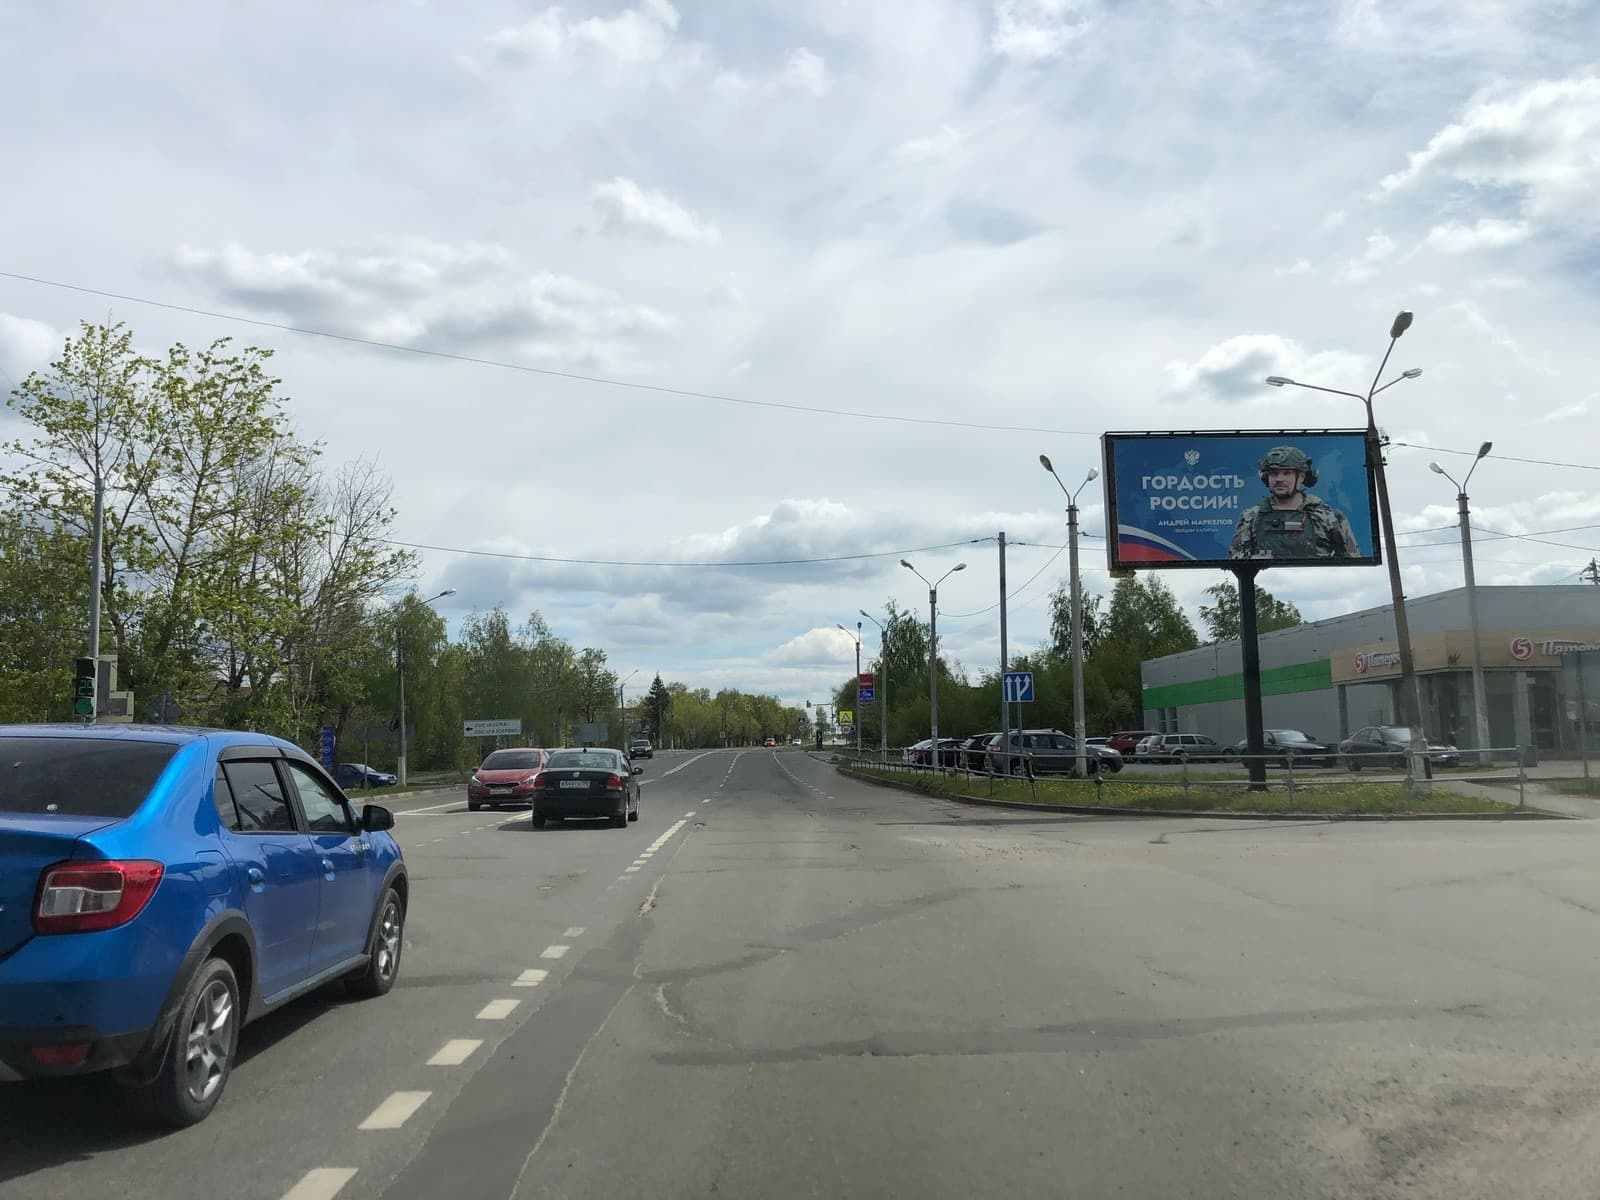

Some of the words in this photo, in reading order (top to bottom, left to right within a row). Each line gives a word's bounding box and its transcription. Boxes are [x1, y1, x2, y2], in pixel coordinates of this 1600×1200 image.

[1142, 475, 1245, 491] ГОРДОСТЬ
[1150, 495, 1239, 510] РОССИИ!
[1158, 518, 1190, 527] АНДРЕЙ
